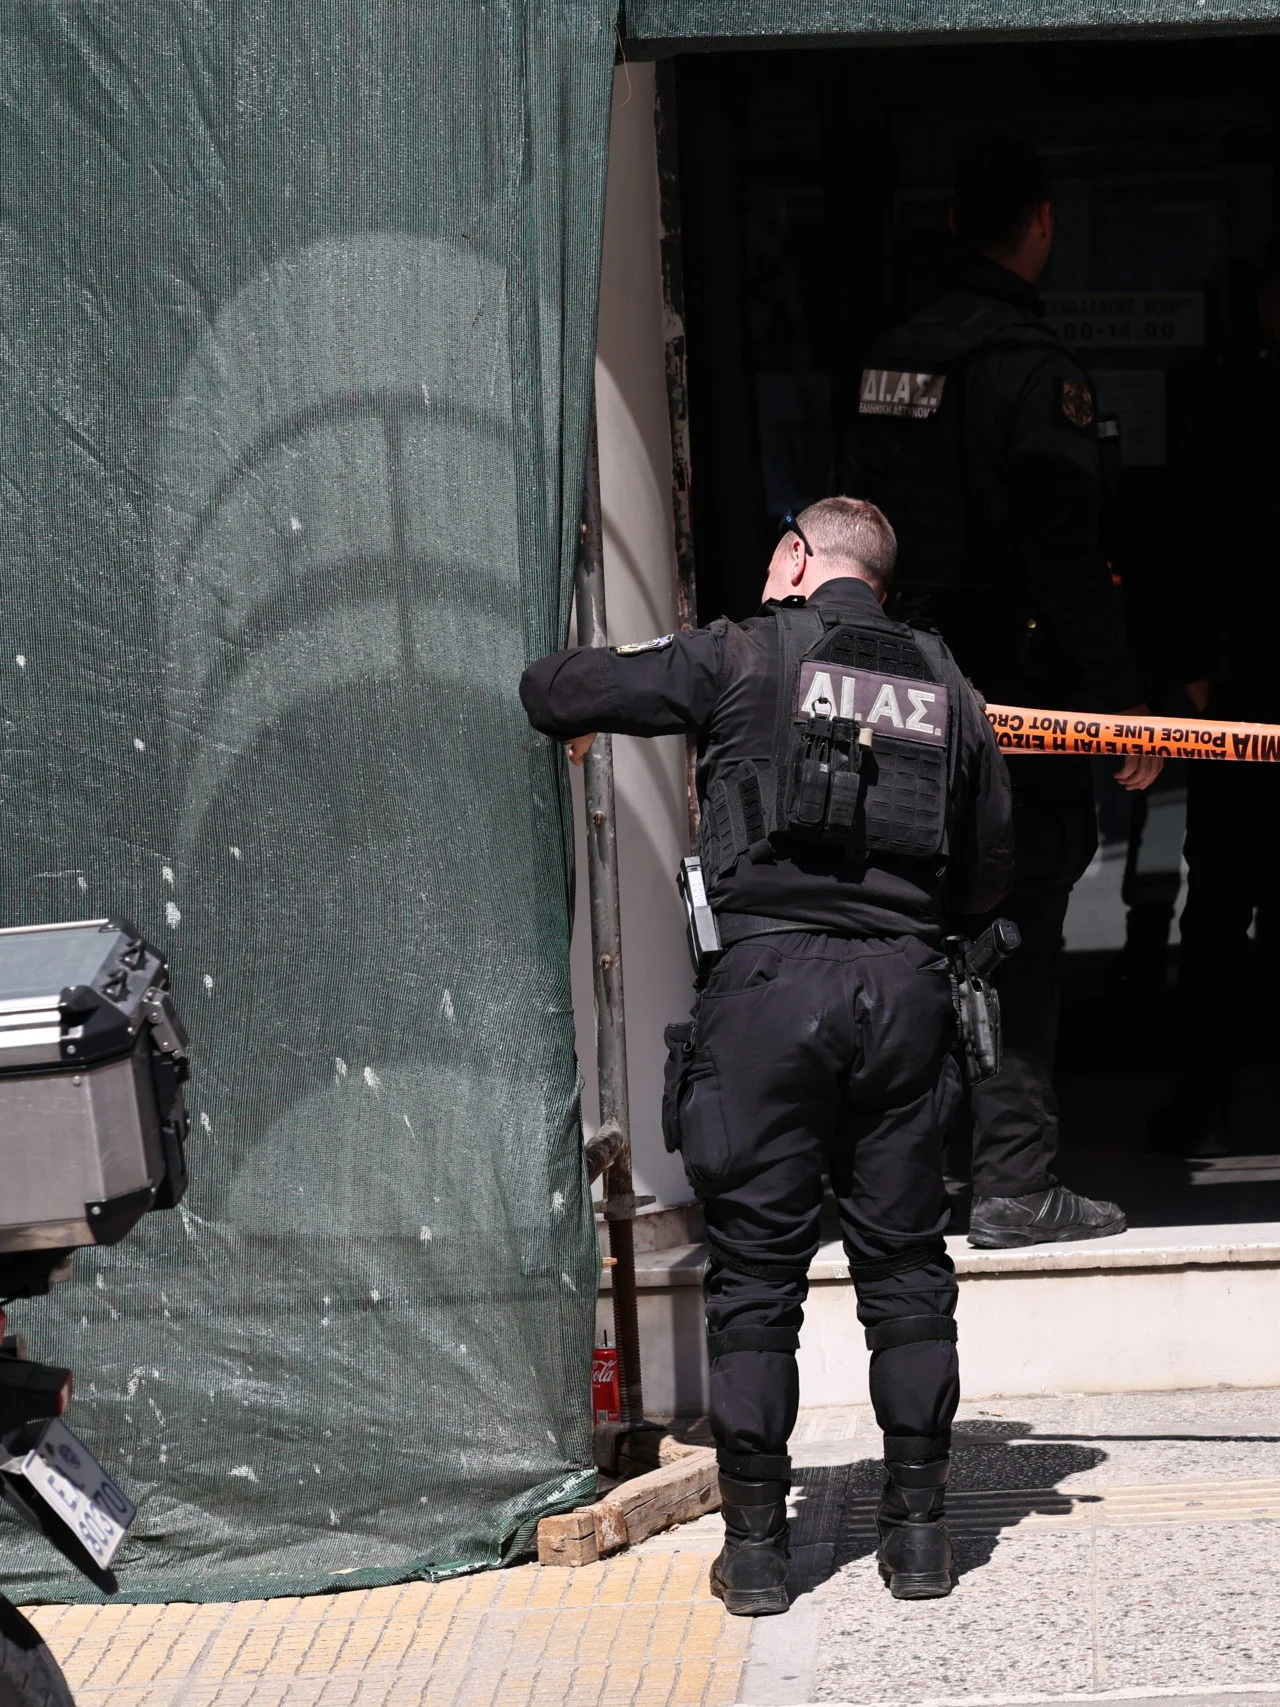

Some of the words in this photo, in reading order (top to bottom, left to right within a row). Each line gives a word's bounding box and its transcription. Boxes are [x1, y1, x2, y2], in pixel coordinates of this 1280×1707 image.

[862, 369, 937, 405] ΔΙ.ΑΣ.
[987, 712, 1025, 732] CRO
[1029, 716, 1068, 735] NOT
[1073, 720, 1100, 738] DO
[1113, 723, 1155, 743] LINE
[1161, 728, 1227, 748] POLICE
